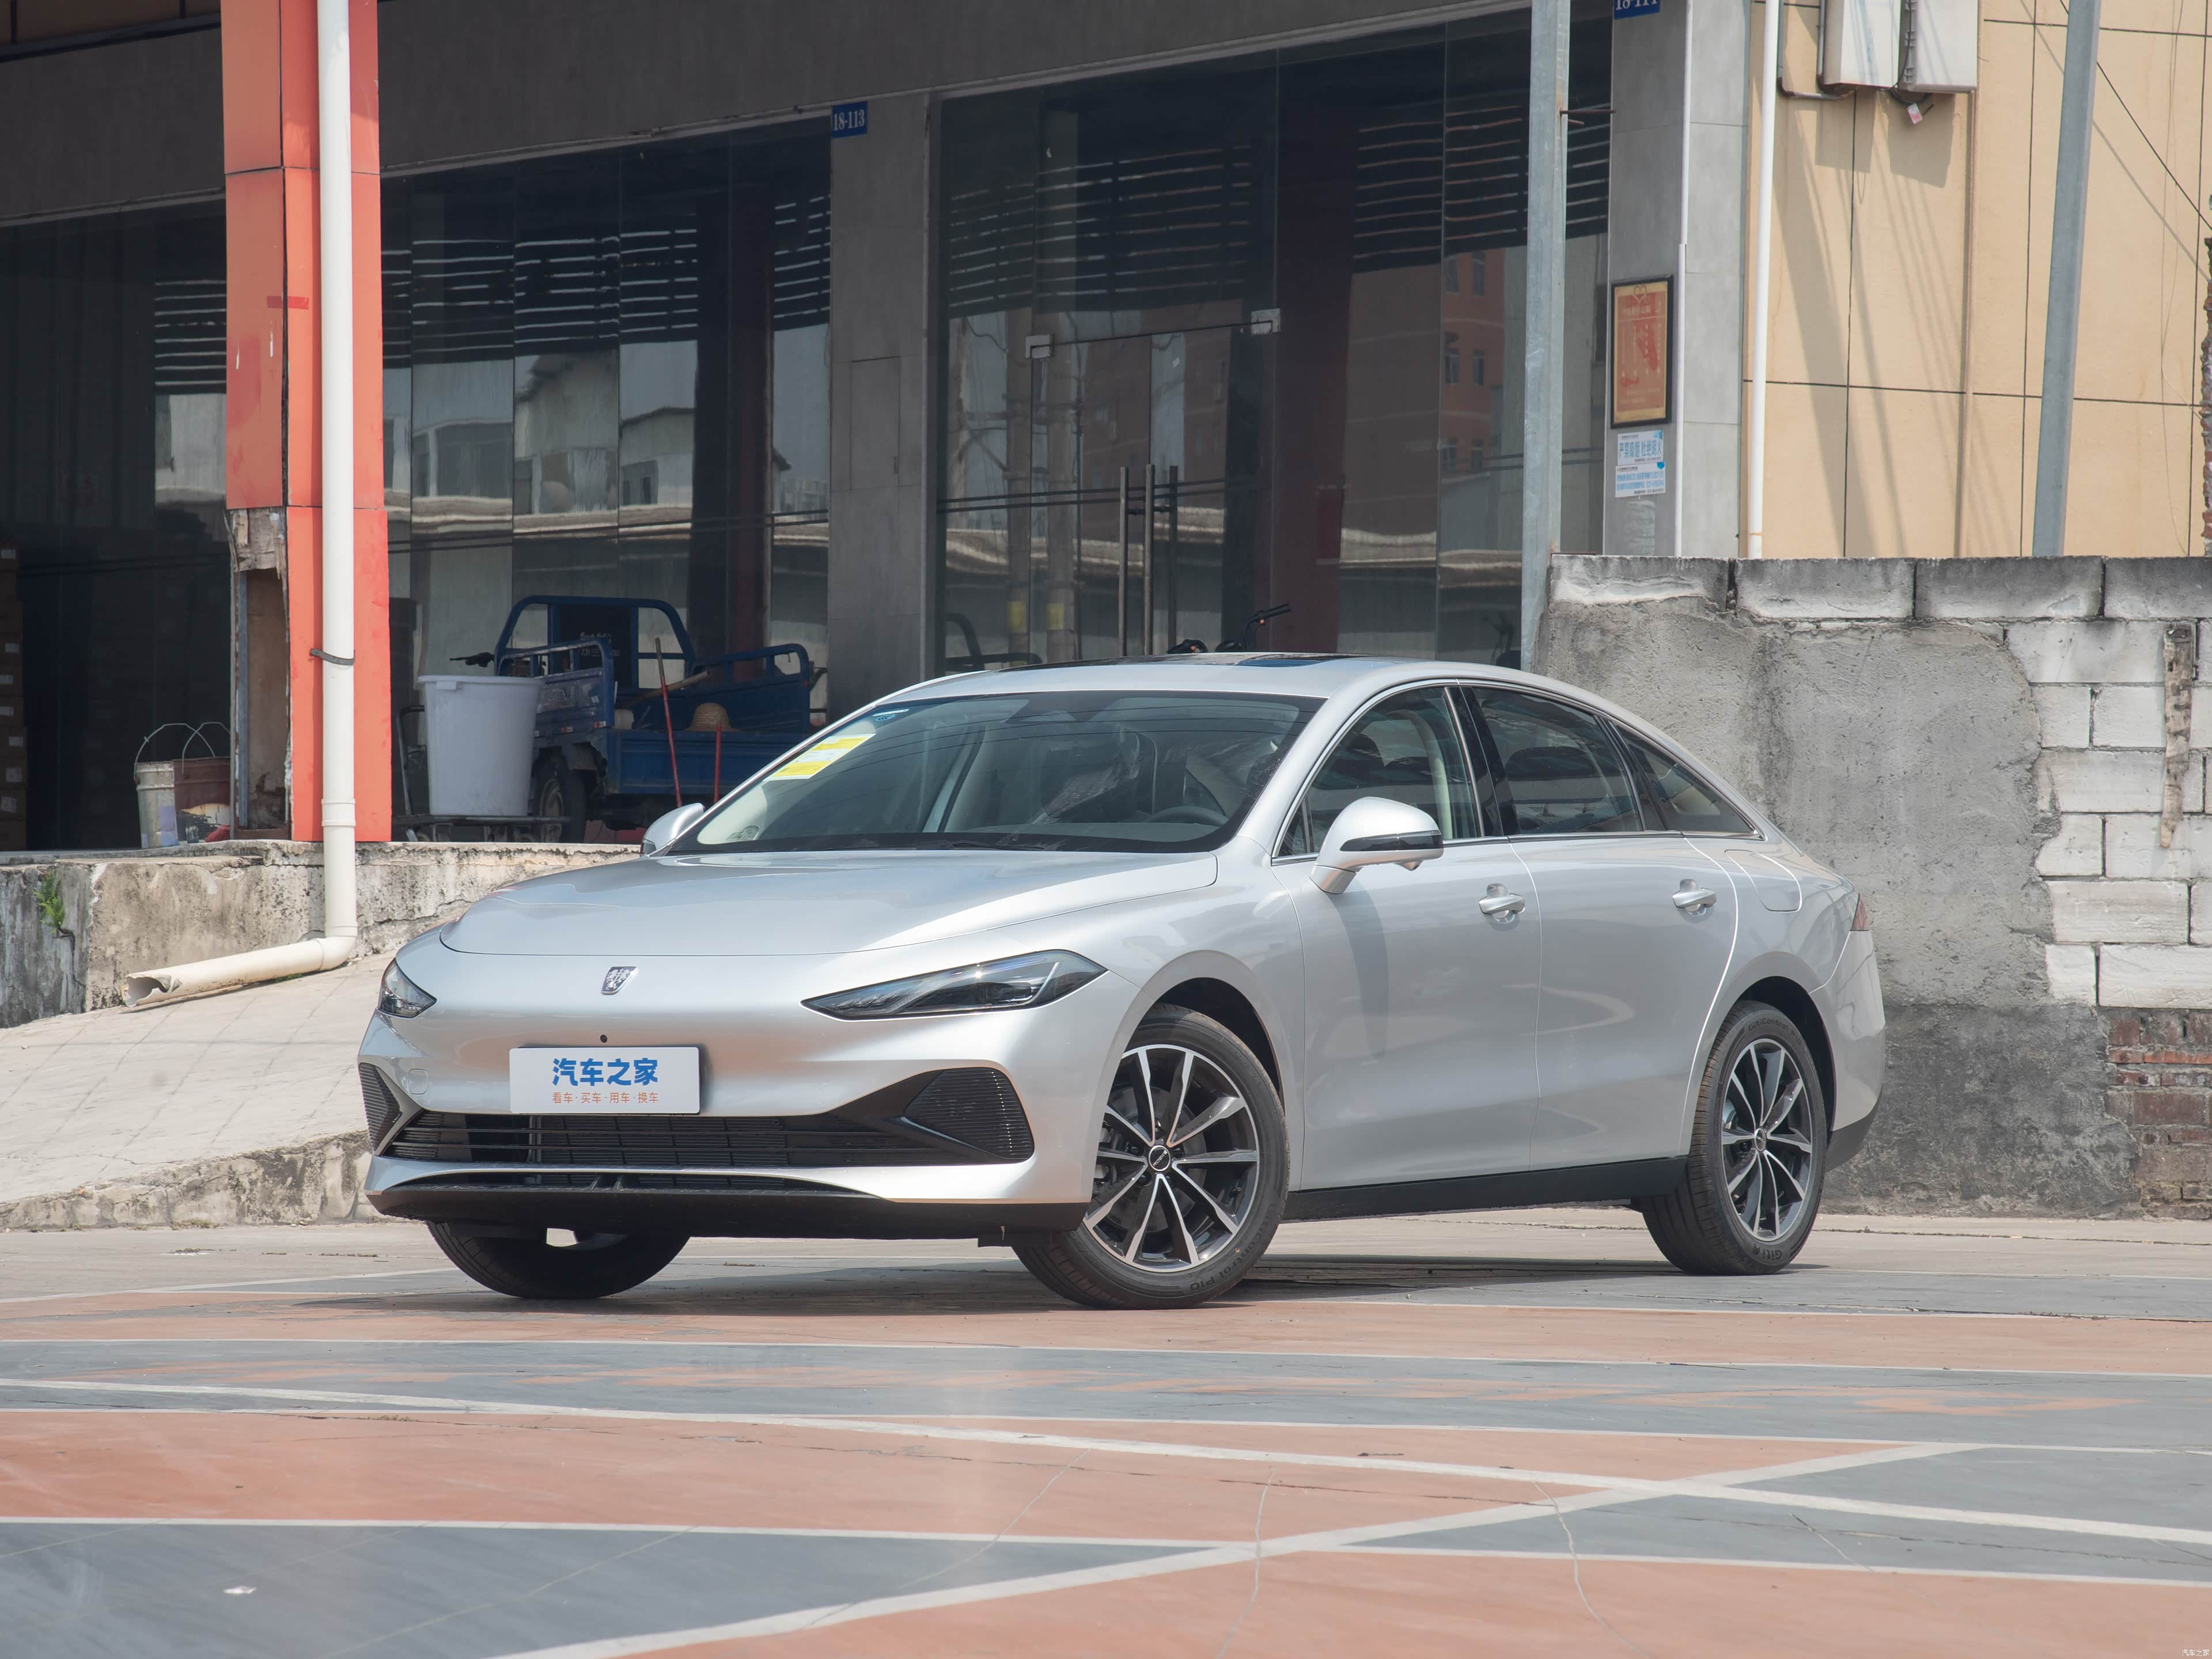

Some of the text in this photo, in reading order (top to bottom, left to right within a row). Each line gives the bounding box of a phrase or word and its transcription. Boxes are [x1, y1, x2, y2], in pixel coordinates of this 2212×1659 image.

[834, 109, 865, 131] 18-113
[1748, 1017, 1789, 1032] GitiControl
[552, 1057, 658, 1086] 汽车之家
[1762, 1248, 1782, 1261] Giti
[1190, 1276, 1215, 1291] P10
